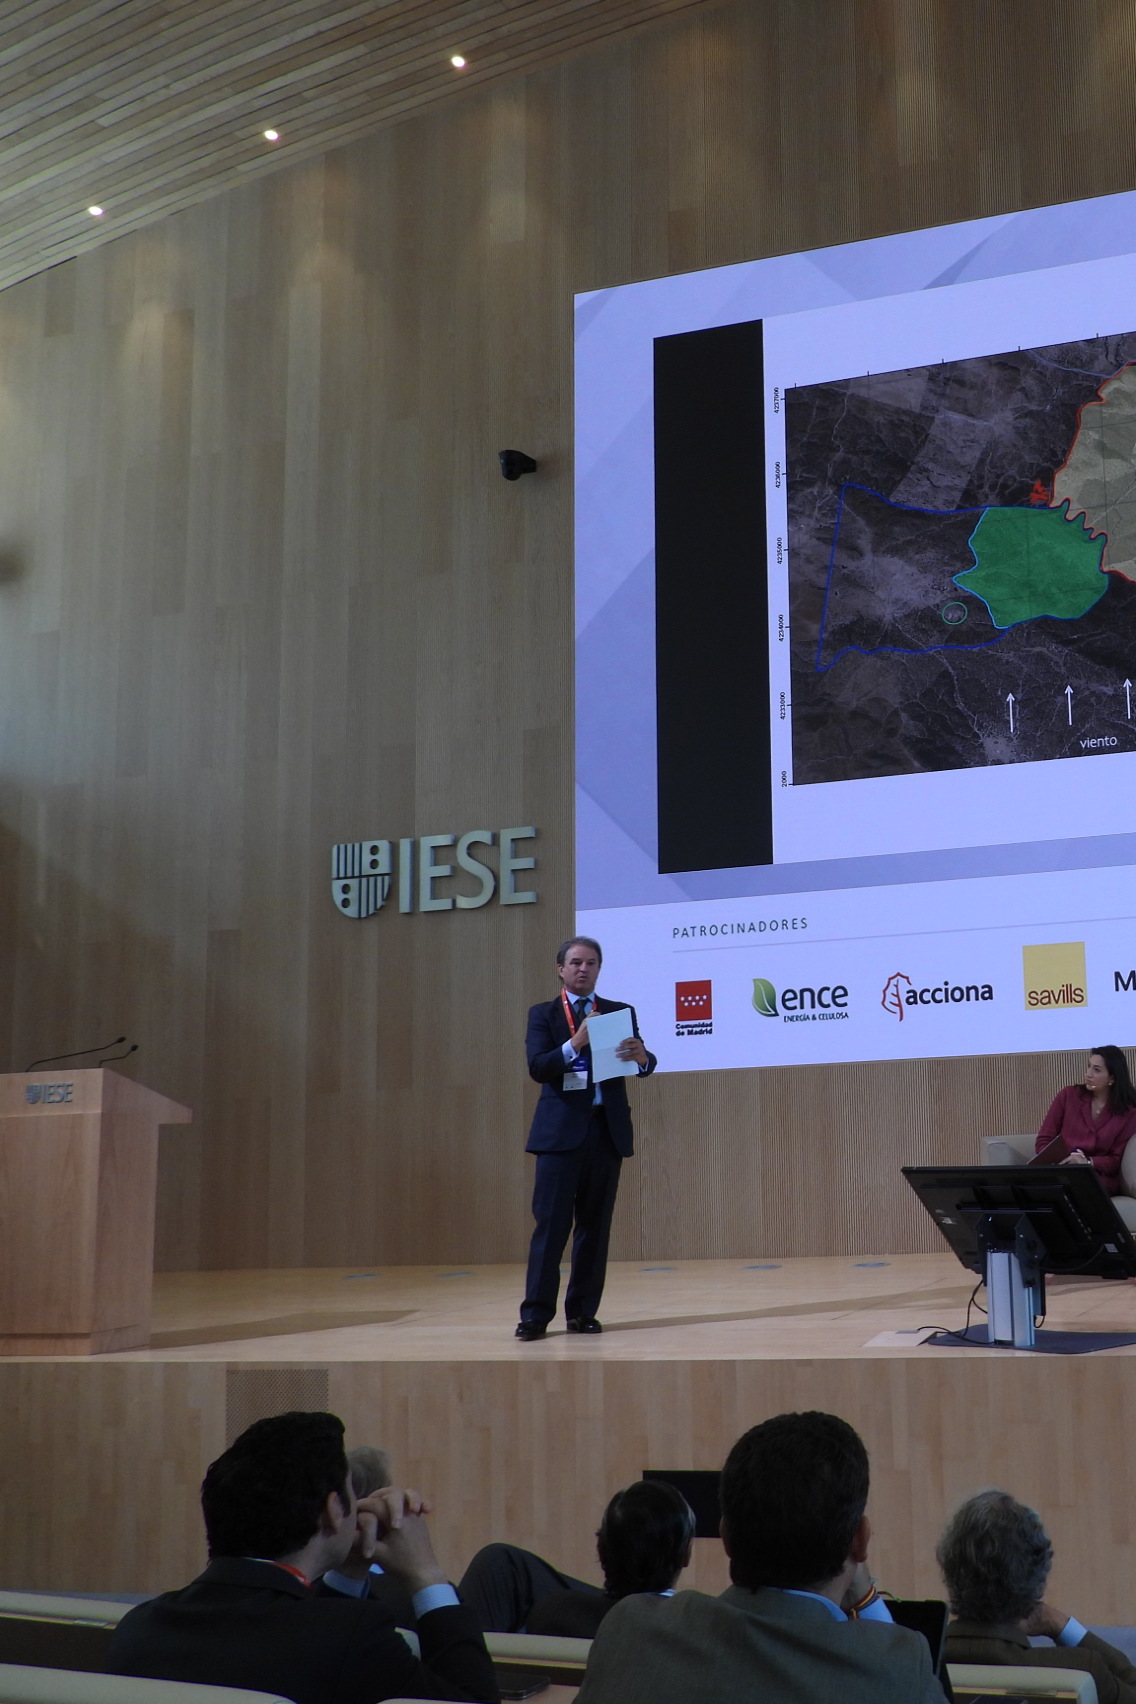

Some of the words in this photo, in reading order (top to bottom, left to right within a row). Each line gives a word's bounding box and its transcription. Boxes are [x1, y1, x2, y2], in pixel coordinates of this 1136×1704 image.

[1079, 735, 1118, 748] viento
[399, 826, 538, 914] IESE
[672, 917, 809, 939] PATROCINADORES
[781, 985, 849, 1011] ence
[905, 980, 994, 1006] acciona
[1027, 983, 1085, 1007] savills
[675, 1021, 713, 1029] Comunidad
[687, 1028, 713, 1036] Madrid
[41, 1081, 74, 1104] IESE
